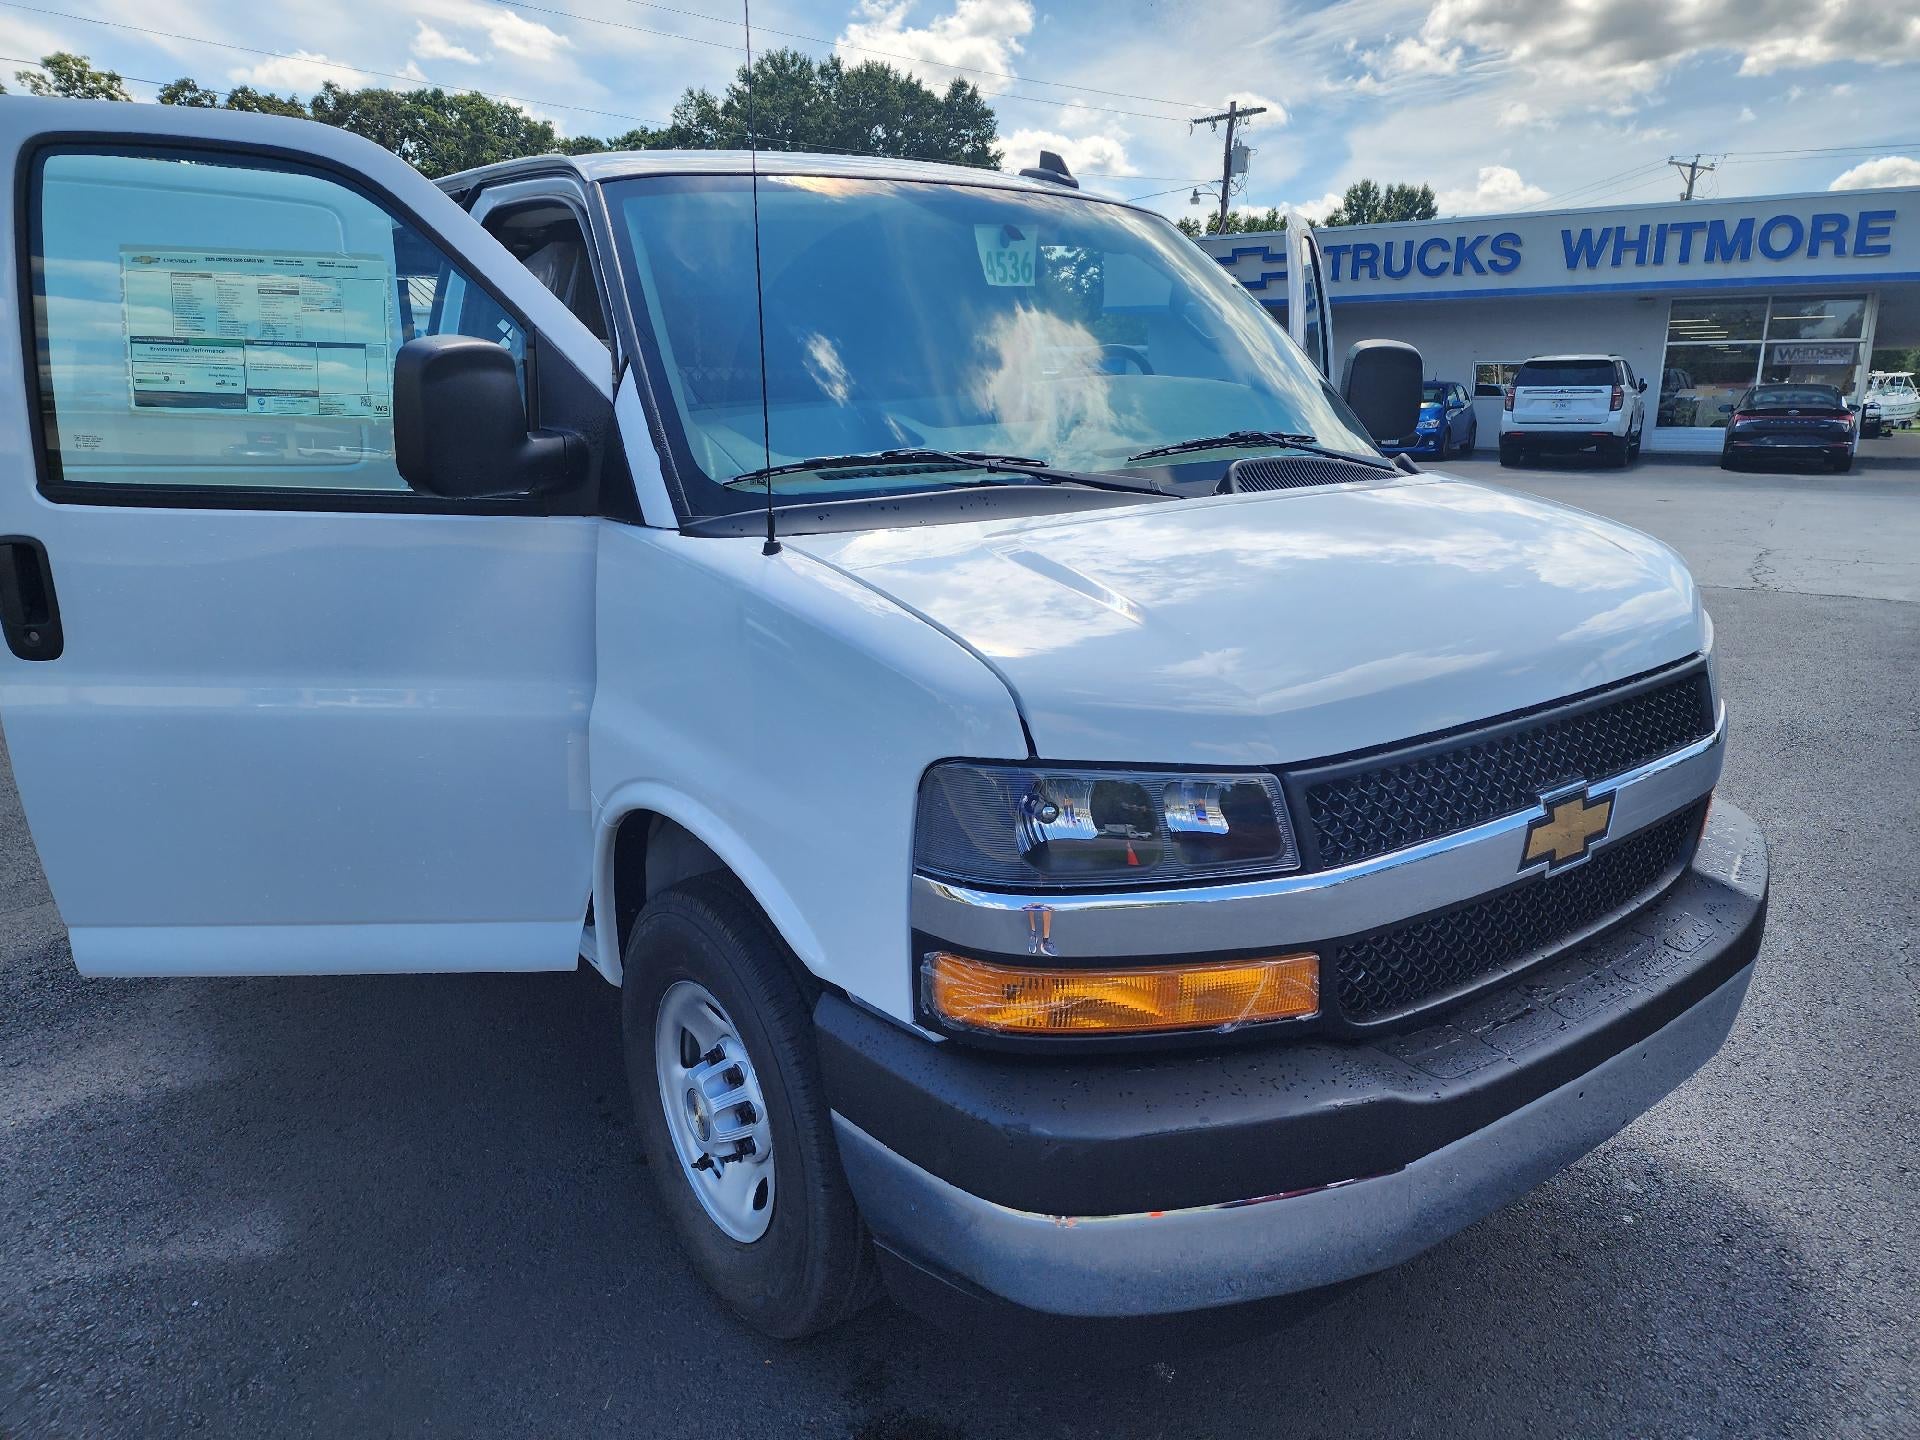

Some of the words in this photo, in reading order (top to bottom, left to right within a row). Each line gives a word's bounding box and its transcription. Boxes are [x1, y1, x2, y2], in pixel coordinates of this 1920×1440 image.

[985, 251, 1033, 283] 4536
[1324, 231, 1522, 282] TRUCKS
[1561, 210, 1896, 271] WHITMORE
